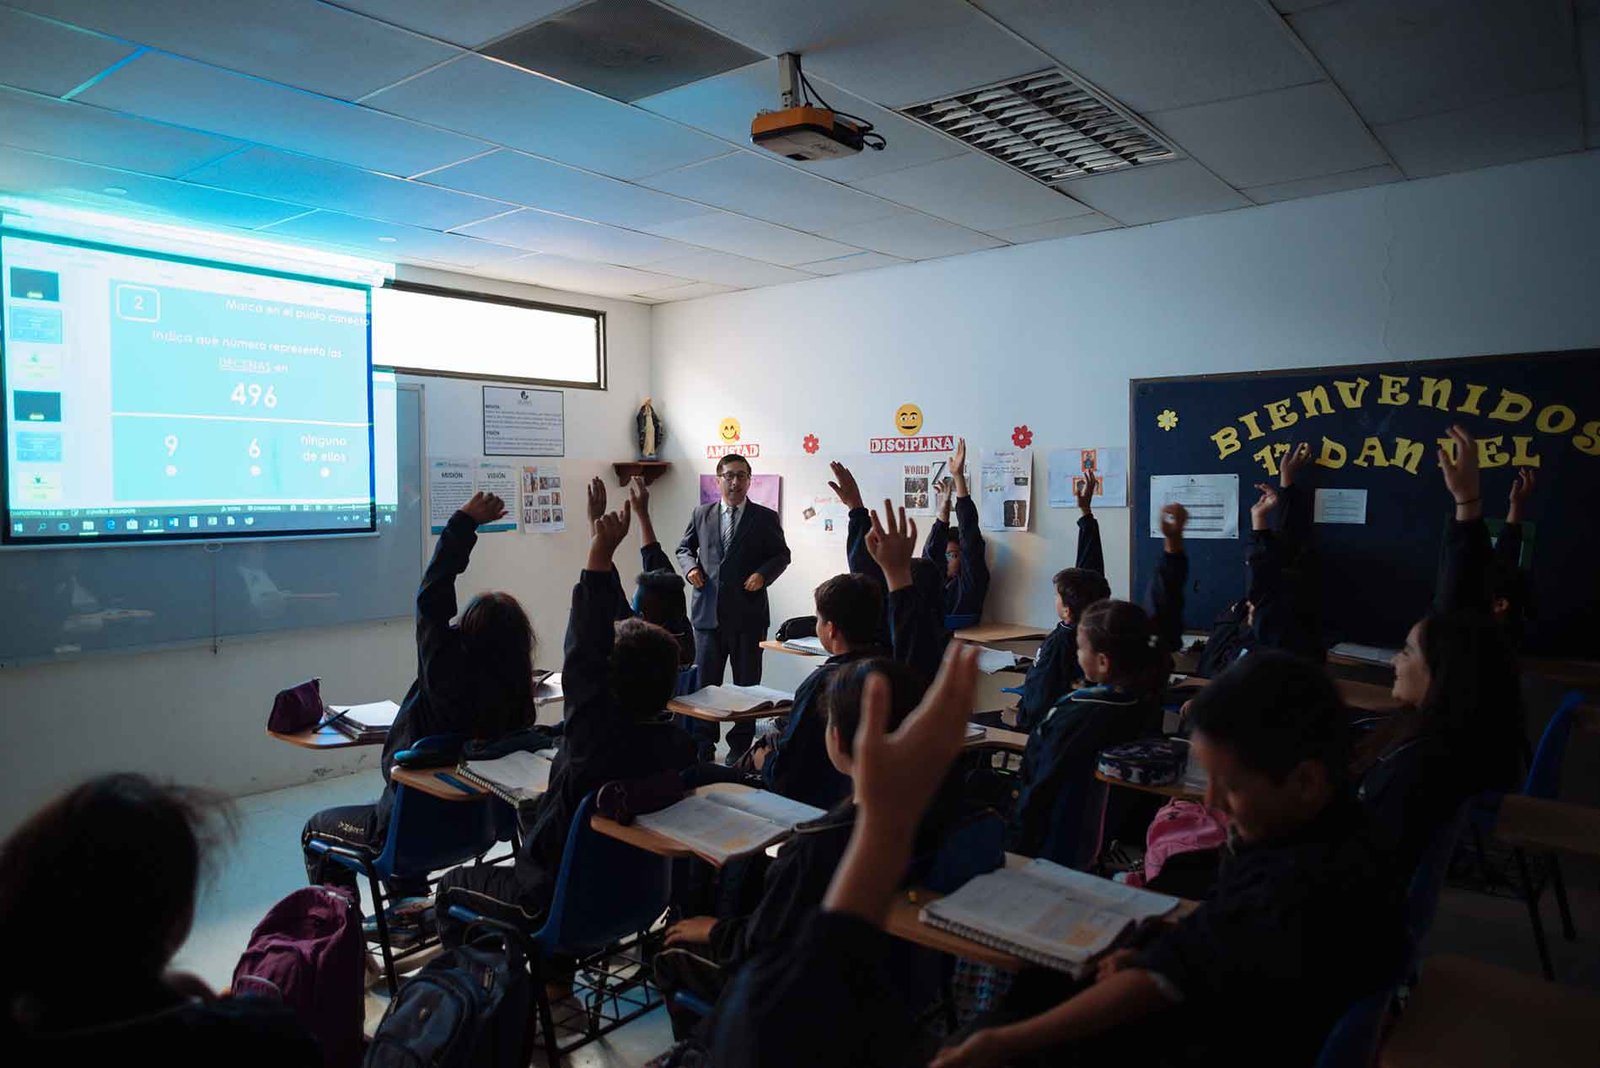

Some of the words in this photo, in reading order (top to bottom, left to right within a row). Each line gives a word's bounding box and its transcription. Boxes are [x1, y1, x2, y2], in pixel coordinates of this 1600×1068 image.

[133, 296, 144, 310] 2
[230, 382, 278, 409] 496
[163, 434, 179, 457] 9
[247, 438, 261, 458] 6
[871, 437, 953, 453] DISCIPLINA
[904, 464, 930, 475] WORLD
